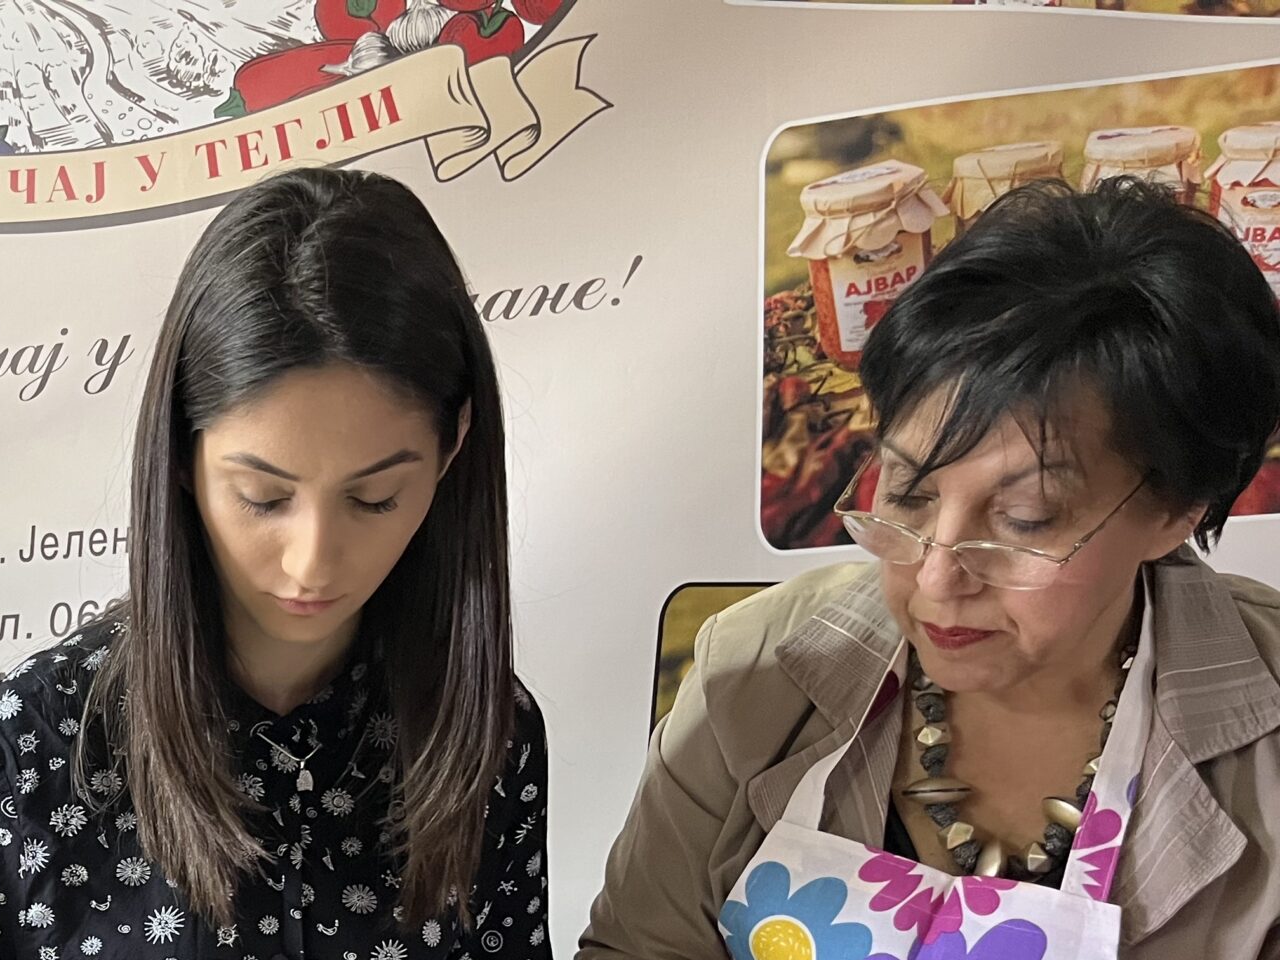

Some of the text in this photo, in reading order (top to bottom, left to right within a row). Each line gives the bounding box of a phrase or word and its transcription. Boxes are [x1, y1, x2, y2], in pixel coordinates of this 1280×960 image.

[134, 150, 167, 193] У
[193, 84, 403, 180] ТЕГЛИ
[83, 333, 136, 395] у
[470, 254, 644, 322] ане!
[18, 524, 131, 563] Јелен
[49, 598, 126, 638] 06
